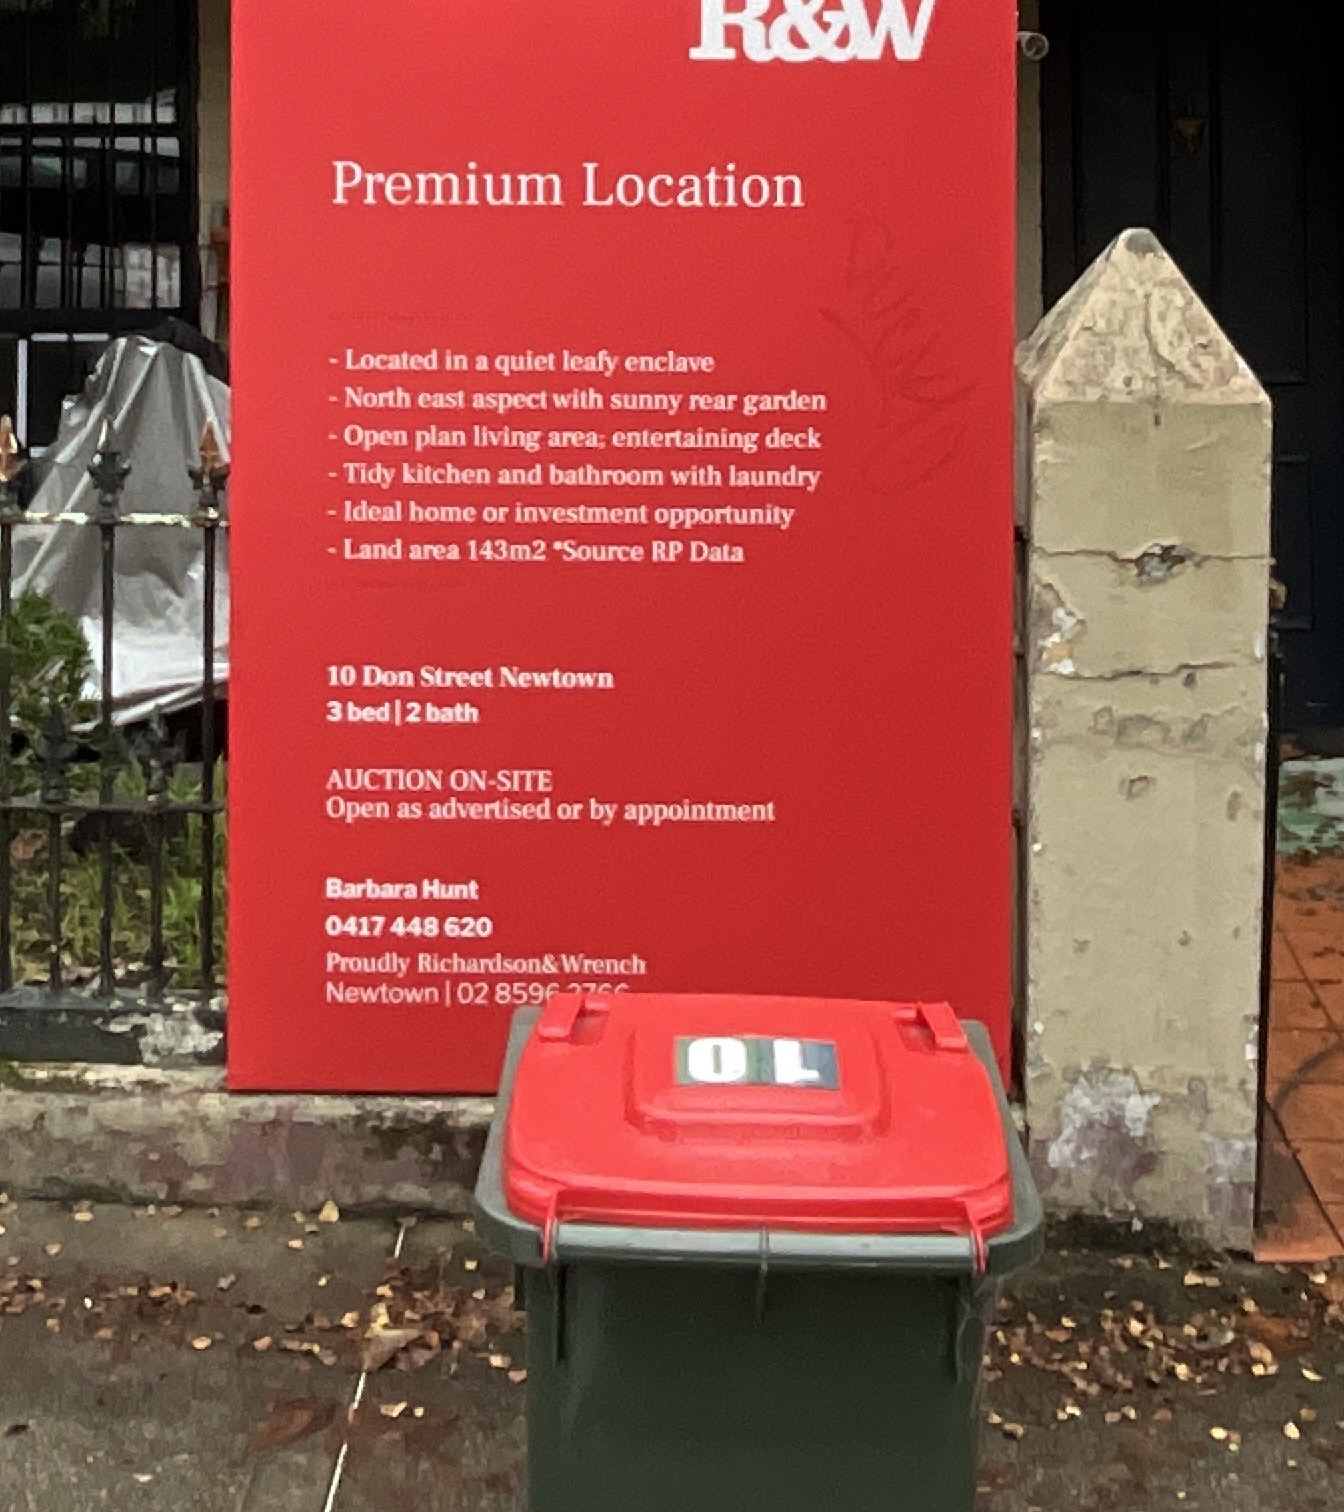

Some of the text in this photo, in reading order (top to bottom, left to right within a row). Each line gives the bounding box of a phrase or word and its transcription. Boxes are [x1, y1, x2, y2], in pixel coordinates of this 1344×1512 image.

[332, 160, 806, 208] Premium Location
[345, 348, 439, 371] Located
[445, 349, 468, 371] in
[475, 354, 489, 371] a
[494, 349, 556, 377] quiet
[562, 349, 619, 378] leafy
[624, 350, 715, 373] enclave
[344, 386, 412, 409] North
[417, 390, 466, 409] east
[472, 390, 548, 415] aspect
[553, 386, 604, 410] with
[610, 392, 683, 416] sunny
[688, 394, 738, 411] rear
[743, 388, 828, 417] garden
[342, 424, 408, 452] Open
[414, 424, 467, 452] plan
[473, 424, 542, 453] living
[612, 426, 759, 454] entertaining
[764, 426, 822, 450] deck
[342, 462, 396, 490] Tidy
[402, 462, 491, 485] kitchen
[497, 462, 543, 486] and
[548, 462, 664, 486] bathroom
[670, 464, 722, 487] with
[728, 464, 822, 492] laundry
[344, 499, 402, 523] Ideal
[408, 500, 478, 523] home
[482, 506, 510, 524] or
[514, 502, 649, 524] investment
[654, 503, 796, 530] opportunity
[343, 538, 403, 560] Land
[408, 543, 462, 561] area
[467, 538, 547, 562] 143m2
[651, 540, 684, 563] RP
[689, 540, 746, 563] Data
[327, 664, 616, 690] 10 Don Street Newtown
[325, 700, 343, 724] 3
[346, 700, 391, 723] bed
[404, 701, 422, 724] 2
[425, 701, 480, 724] bath
[325, 767, 554, 793] AUCTION ON-SITE
[325, 795, 776, 827] Open as advertised or by appointment
[324, 876, 480, 901] Barbara Hunt
[324, 914, 494, 938] 0417 448 620
[326, 950, 411, 978] Proudly
[326, 980, 440, 1004] Newtown
[456, 981, 490, 1005] 02
